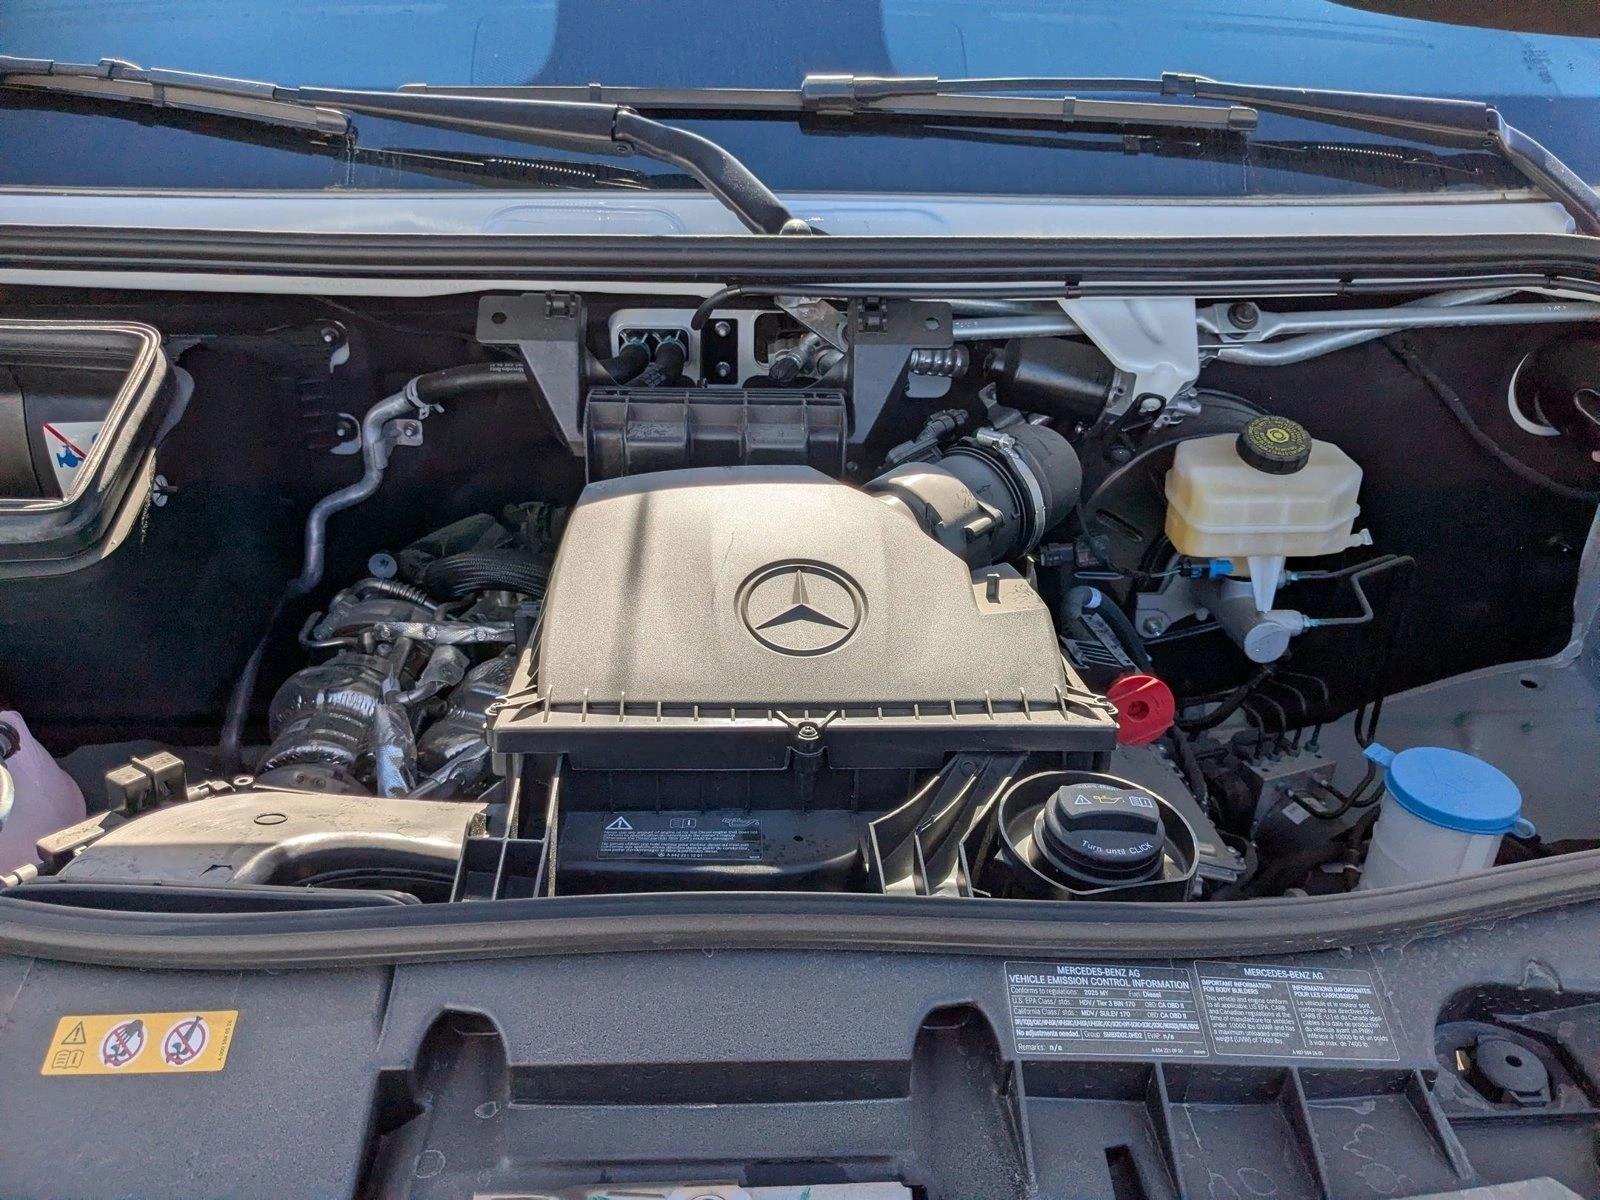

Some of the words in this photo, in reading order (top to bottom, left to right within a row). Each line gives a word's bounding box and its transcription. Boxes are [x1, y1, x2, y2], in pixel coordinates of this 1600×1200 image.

[1082, 840, 1102, 852] Turn
[1129, 842, 1153, 855] CLICK
[1057, 966, 1127, 977] MERCEDES-BENZ
[1129, 969, 1141, 978] AG
[1243, 968, 1311, 979] MERCEDES-BENZ
[1312, 972, 1324, 980] AG
[1009, 975, 1045, 984] VEHICLE
[1047, 976, 1089, 986] EMISSION
[1091, 977, 1131, 987] CONTROL
[1132, 979, 1190, 990] INFORMATION
[1201, 979, 1233, 987] IMPORTANT
[1233, 981, 1272, 989] INFORMATION
[1291, 984, 1333, 992] INFORMATIONS
[1333, 986, 1372, 994] IMPORTANTES
[1321, 992, 1359, 1000] CARROSSIERS
[1013, 1007, 1040, 1015] California
[1099, 1010, 1119, 1018] SULEV
[1025, 1030, 1058, 1038] adjustments
[1163, 1033, 1175, 1041] n/a
[1018, 1043, 1045, 1051] Remarks:
[1049, 1044, 1062, 1052] n/a
